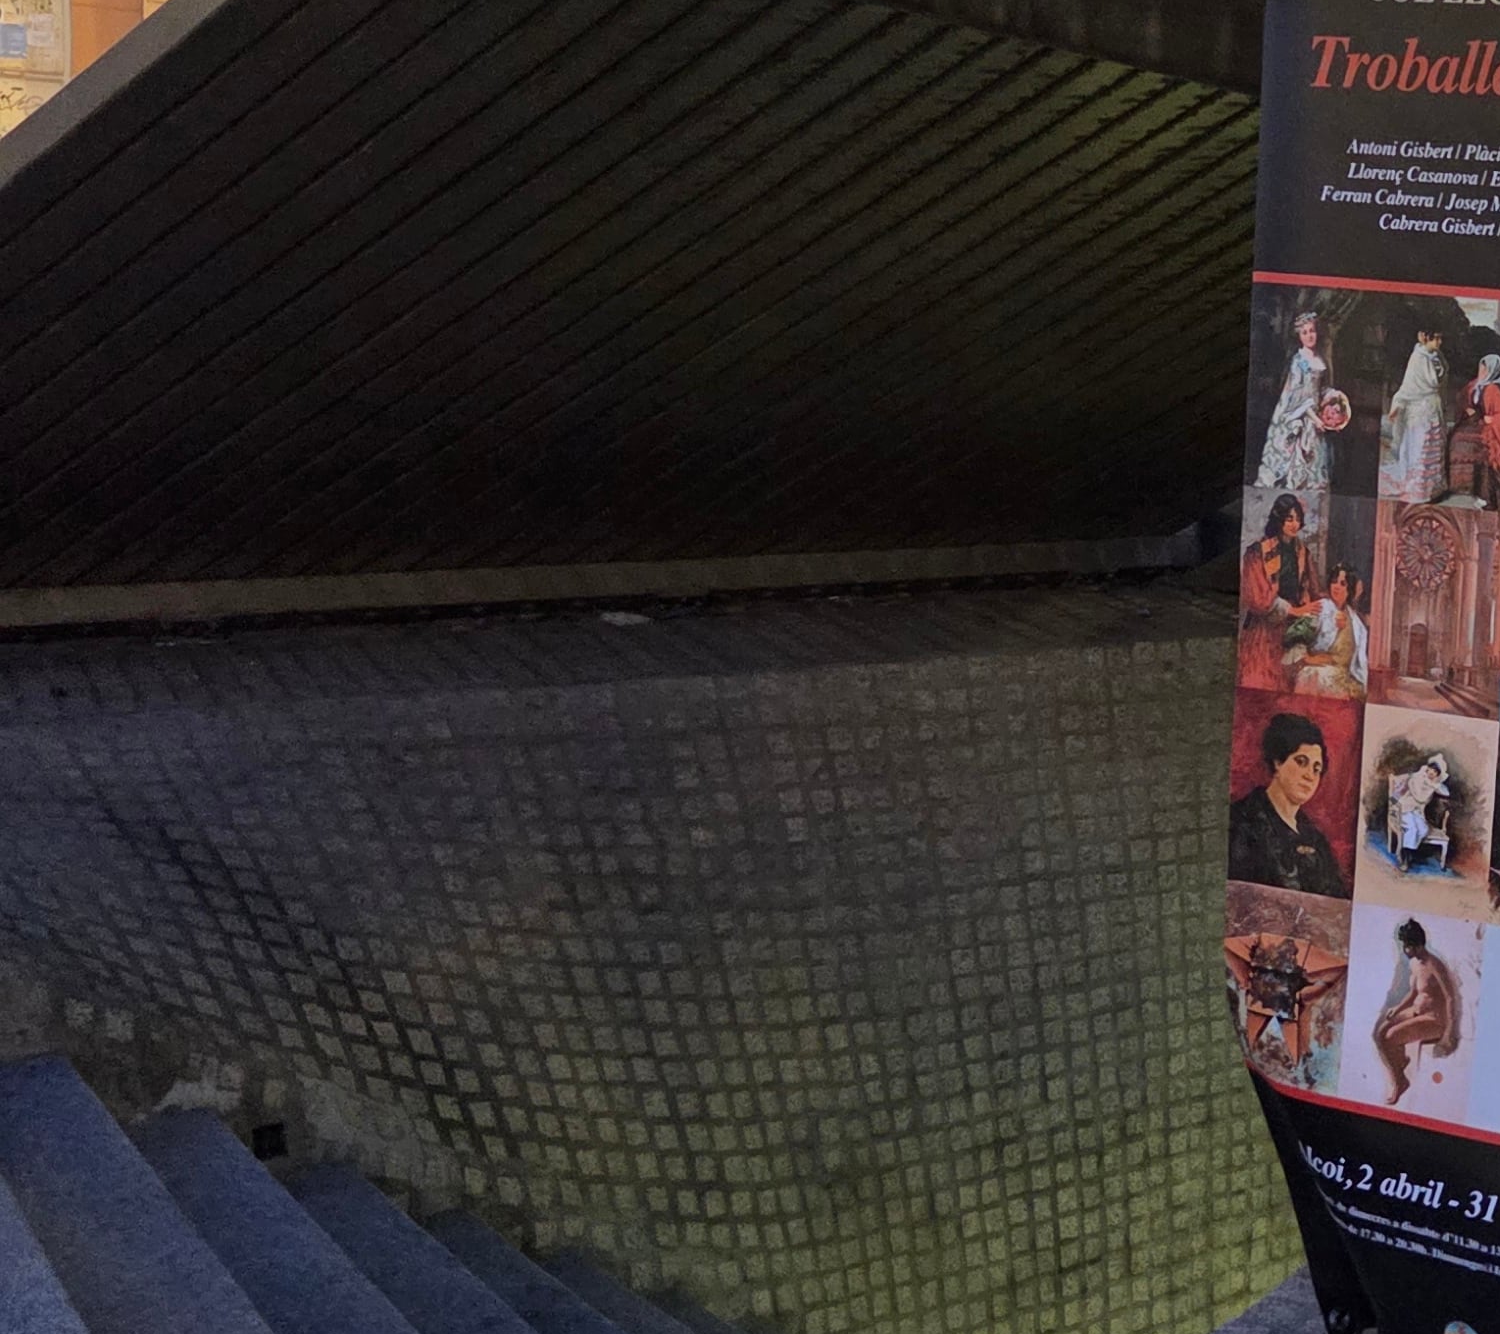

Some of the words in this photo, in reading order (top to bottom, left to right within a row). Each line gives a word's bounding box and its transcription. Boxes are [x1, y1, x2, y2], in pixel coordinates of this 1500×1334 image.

[1346, 138, 1398, 157] Antoni
[1400, 141, 1454, 159] Gisbert
[1347, 162, 1404, 186] Llorenç
[1406, 165, 1479, 186] Casanova
[1320, 185, 1372, 204] Ferran
[1374, 188, 1435, 208] Cabrera
[1444, 193, 1488, 215] Josep
[1378, 213, 1438, 233] Cabrera
[1441, 217, 1496, 237] Gisbert
[1298, 1139, 1353, 1190] lcoi,
[1356, 1163, 1374, 1191] 2
[1379, 1172, 1444, 1209] abril
[1464, 1190, 1499, 1223] 31
